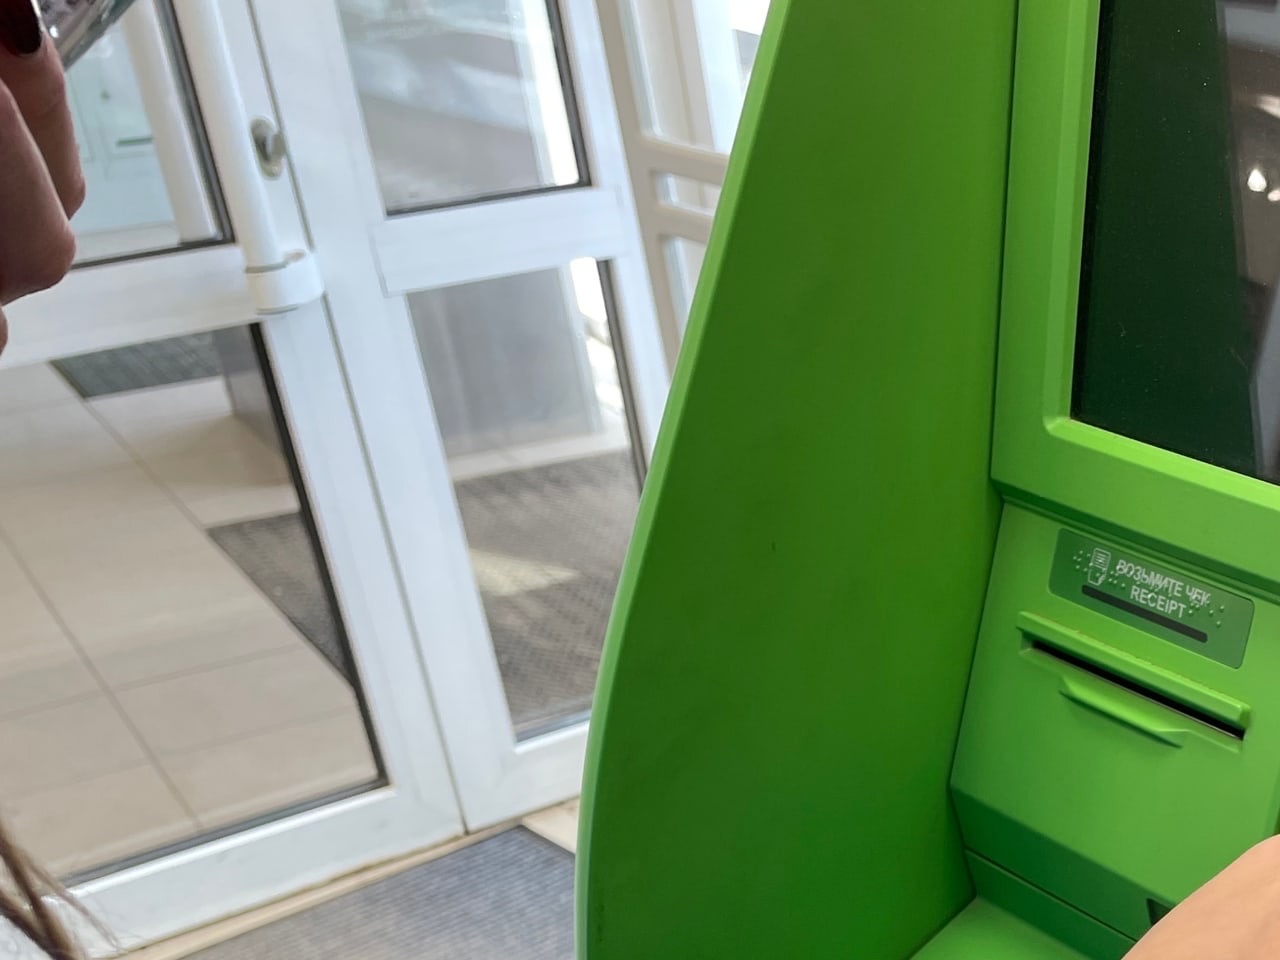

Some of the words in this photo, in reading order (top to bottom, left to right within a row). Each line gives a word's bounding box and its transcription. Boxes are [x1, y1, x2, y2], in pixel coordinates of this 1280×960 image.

[1116, 559, 1184, 597] ВОЗЬМИТЕ
[1186, 585, 1212, 608] ЧЕК
[1130, 585, 1187, 619] RECEIPT
